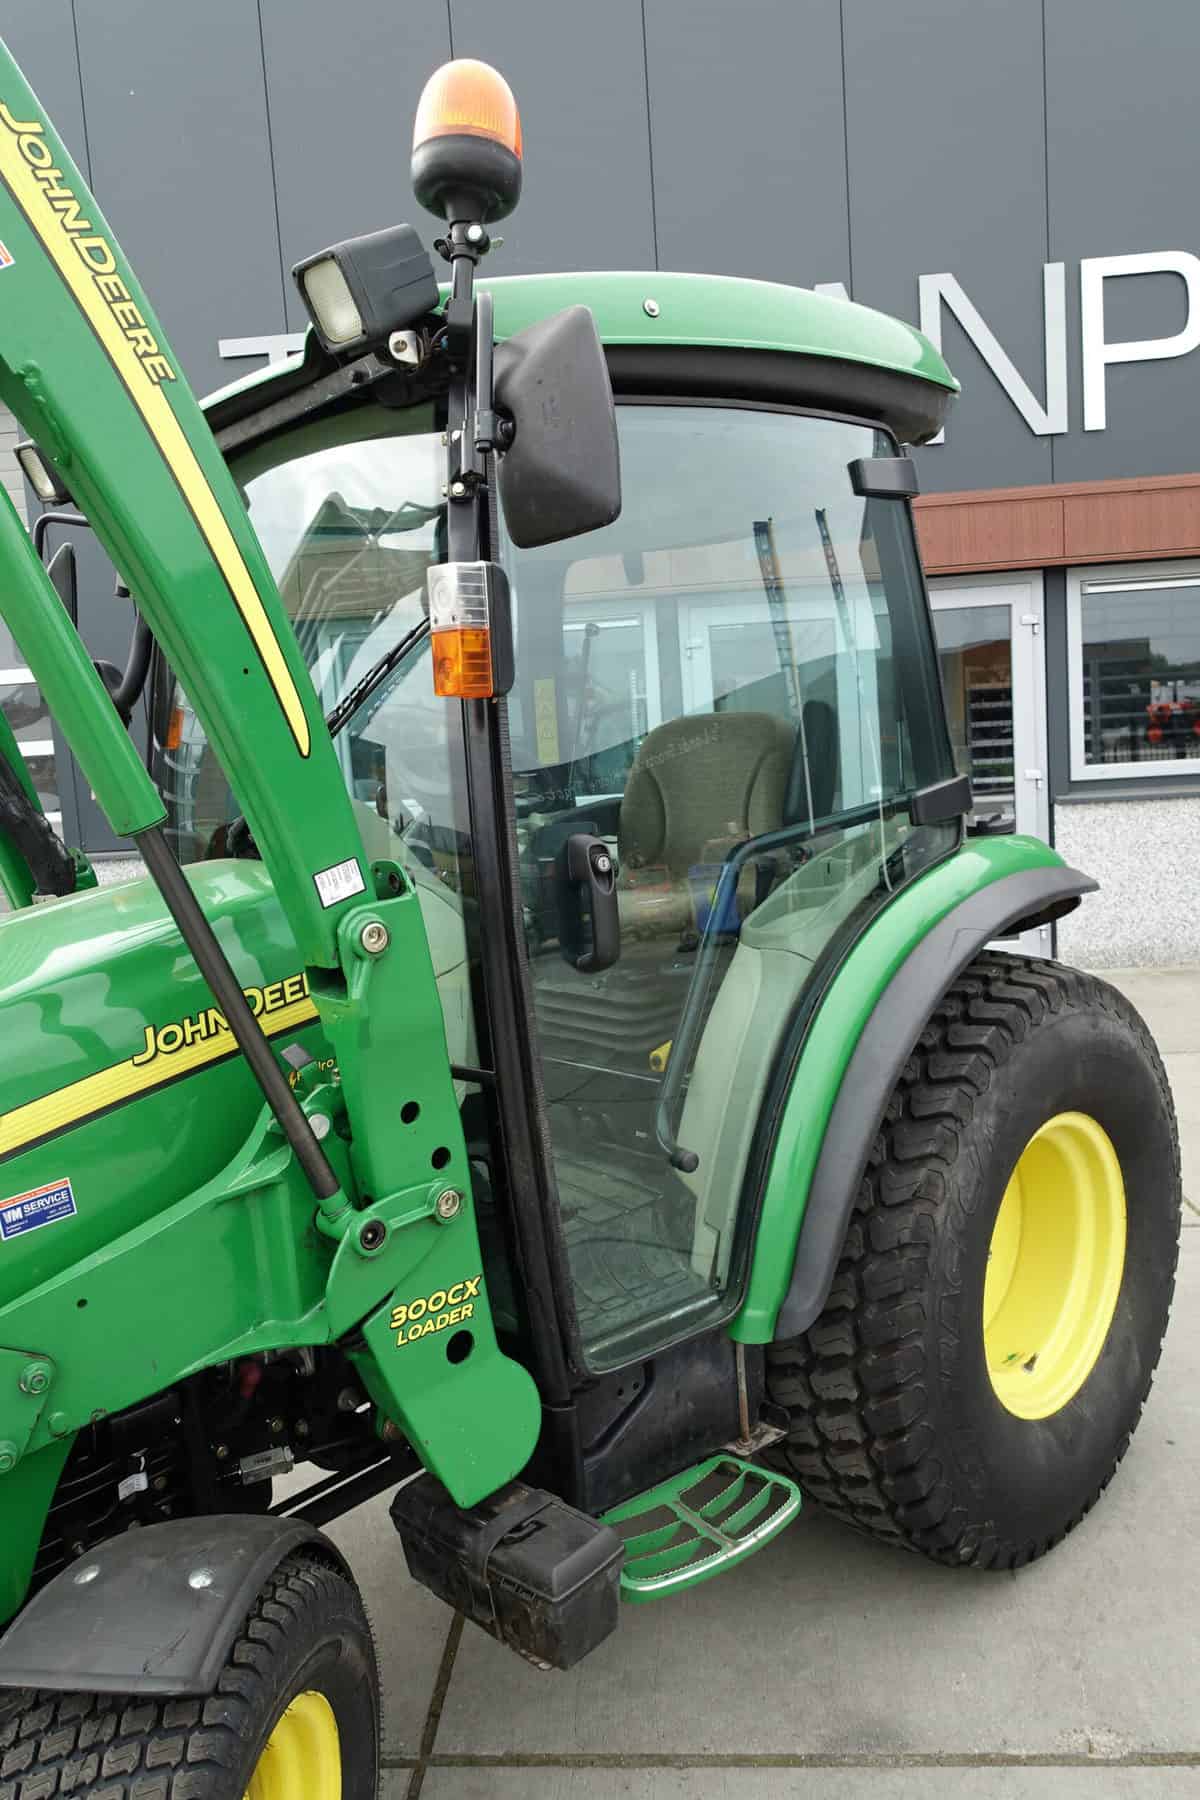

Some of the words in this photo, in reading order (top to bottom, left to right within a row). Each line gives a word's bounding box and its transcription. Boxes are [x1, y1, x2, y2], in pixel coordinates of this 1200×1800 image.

[0, 103, 93, 233] JOHN
[71, 236, 177, 385] DEERE
[815, 250, 1200, 446] NP
[243, 972, 311, 1018] DEE
[23, 1189, 70, 1214] SERVICE
[389, 1274, 482, 1330] 300CX
[396, 1302, 475, 1349] LOADER
